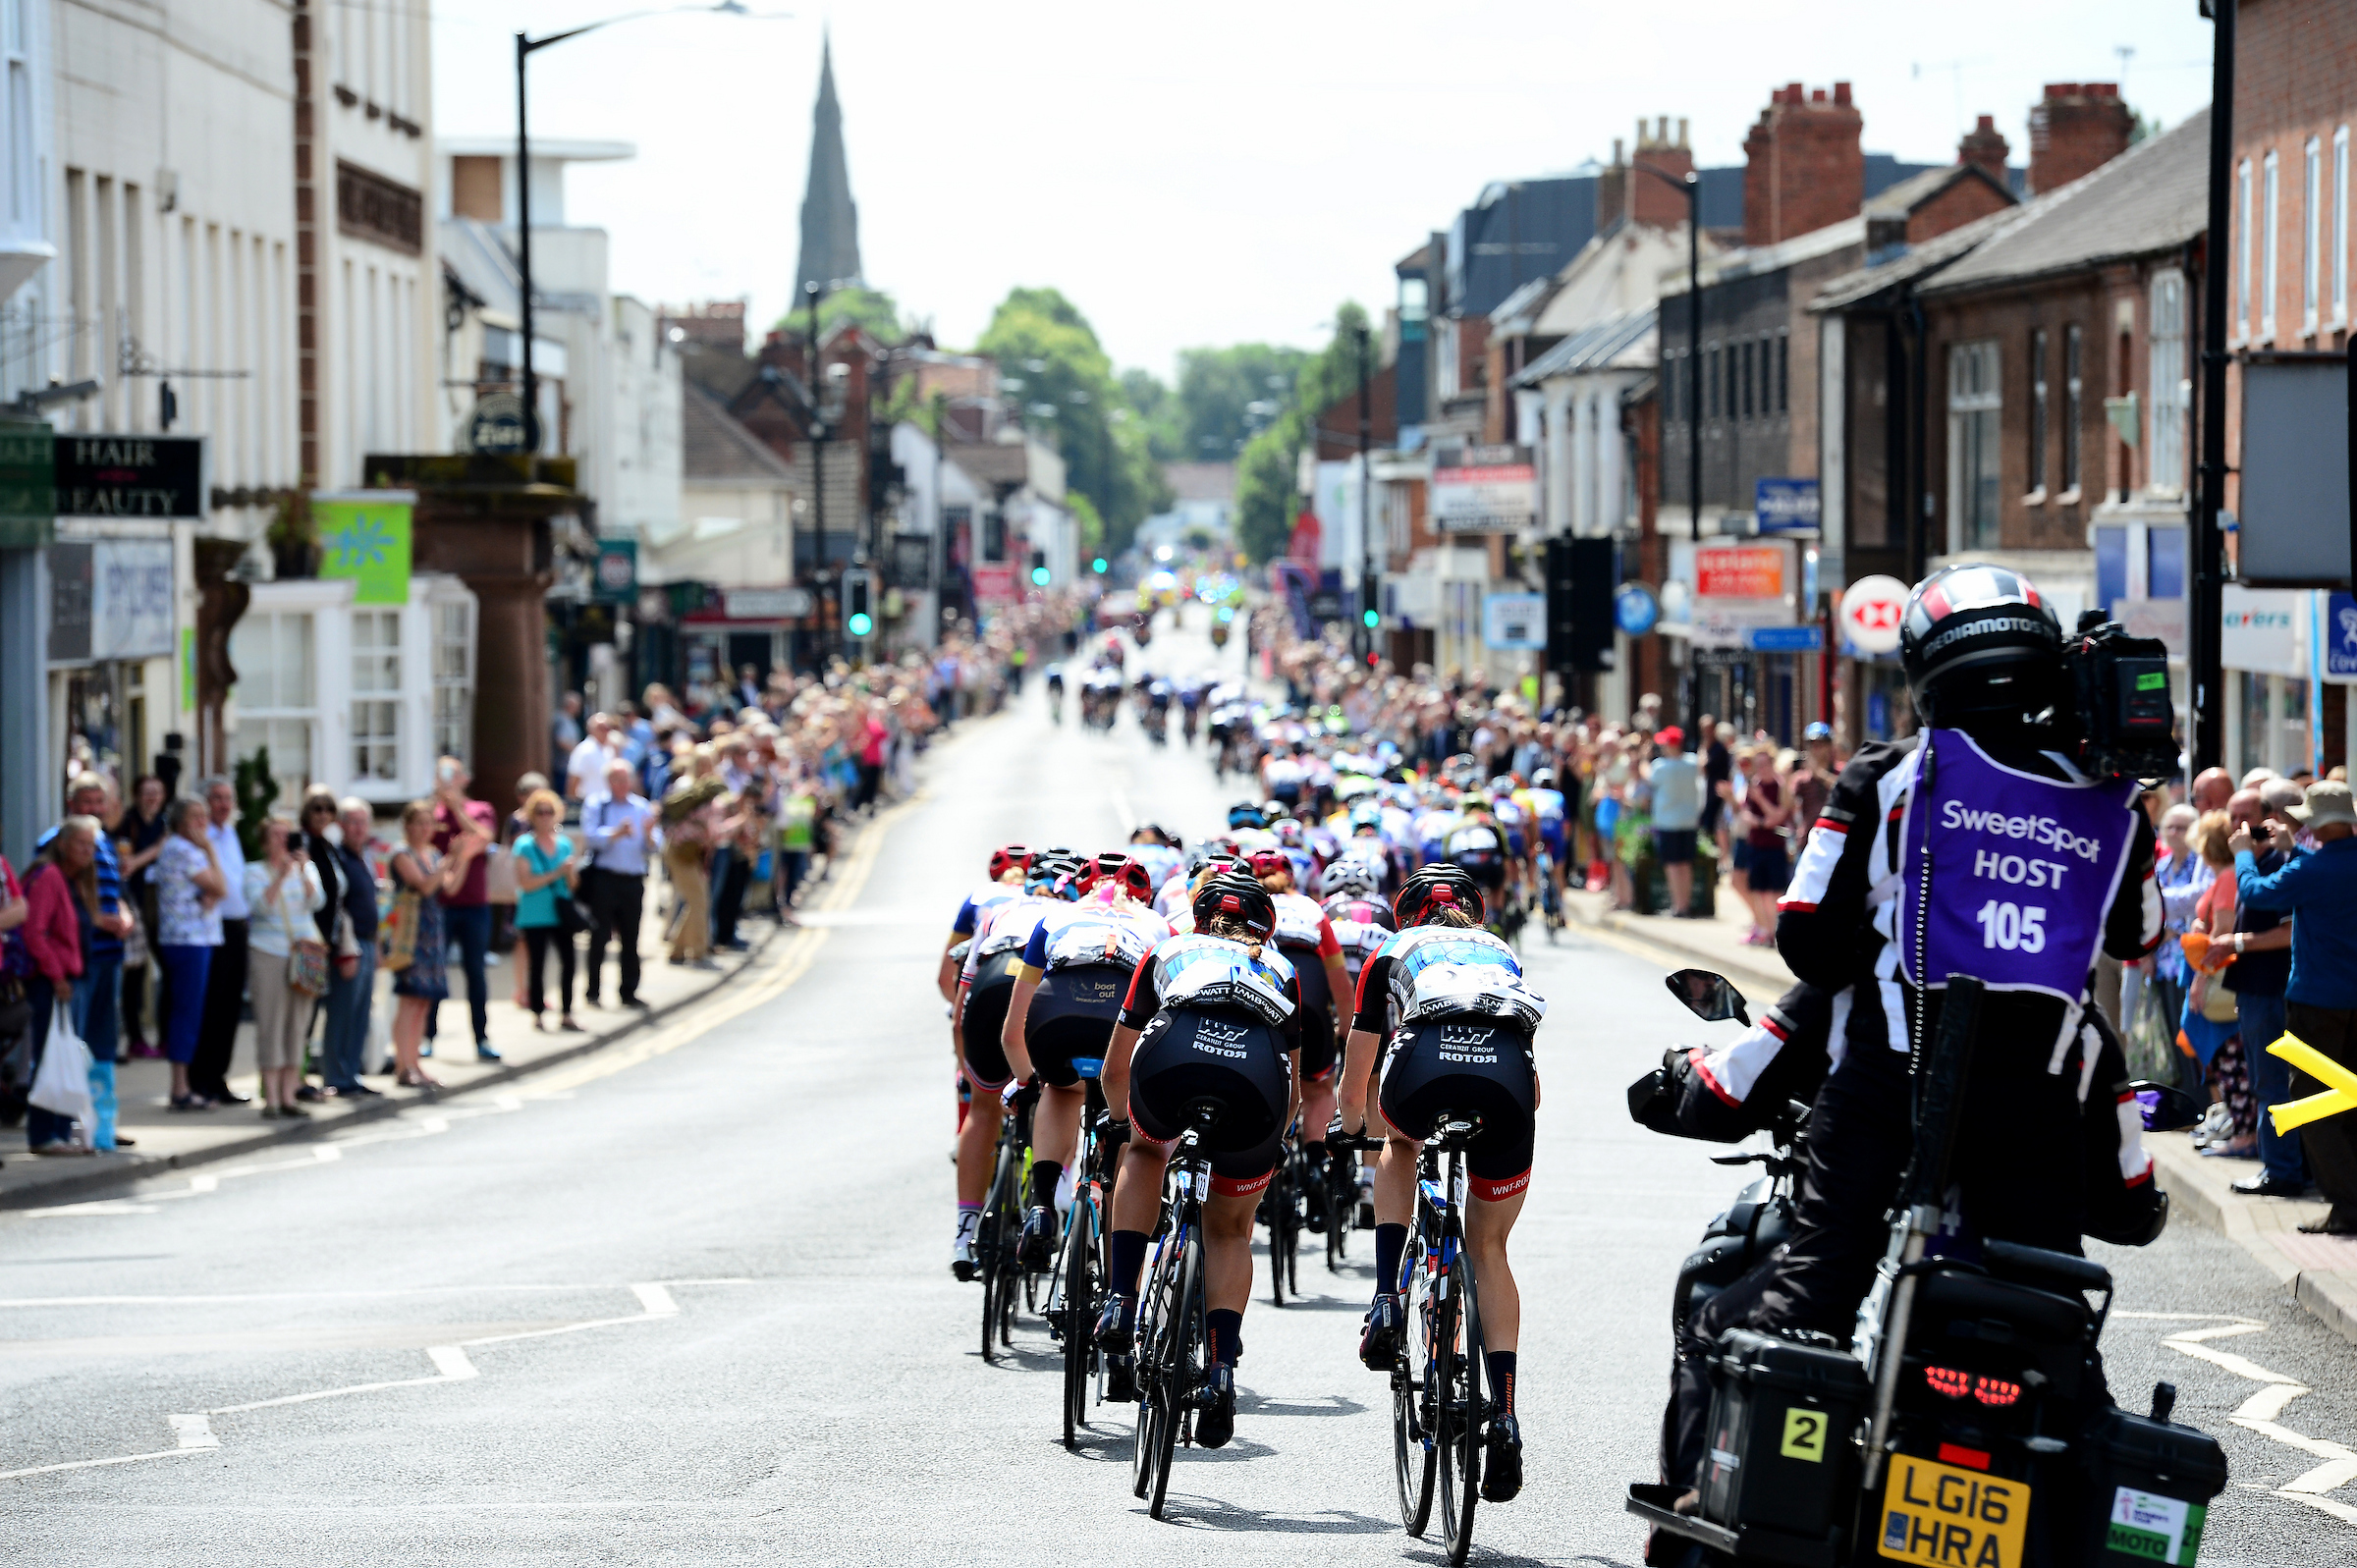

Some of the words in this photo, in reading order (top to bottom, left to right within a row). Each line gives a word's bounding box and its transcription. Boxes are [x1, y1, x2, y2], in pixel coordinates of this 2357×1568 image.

[76, 441, 158, 466] HAIR
[2224, 607, 2290, 627] avers
[1941, 799, 2101, 864] SweetSpot
[1973, 849, 2069, 891] HOST
[1976, 899, 2047, 954] 105
[1094, 982, 1117, 991] boot
[1192, 1040, 1247, 1059] ROTOR
[1439, 1051, 1498, 1063] ROTOR
[1790, 1416, 1820, 1449] 2
[1903, 1465, 2011, 1525] LG16
[1909, 1516, 2001, 1568] HRA
[2109, 1530, 2168, 1556] MOTO
